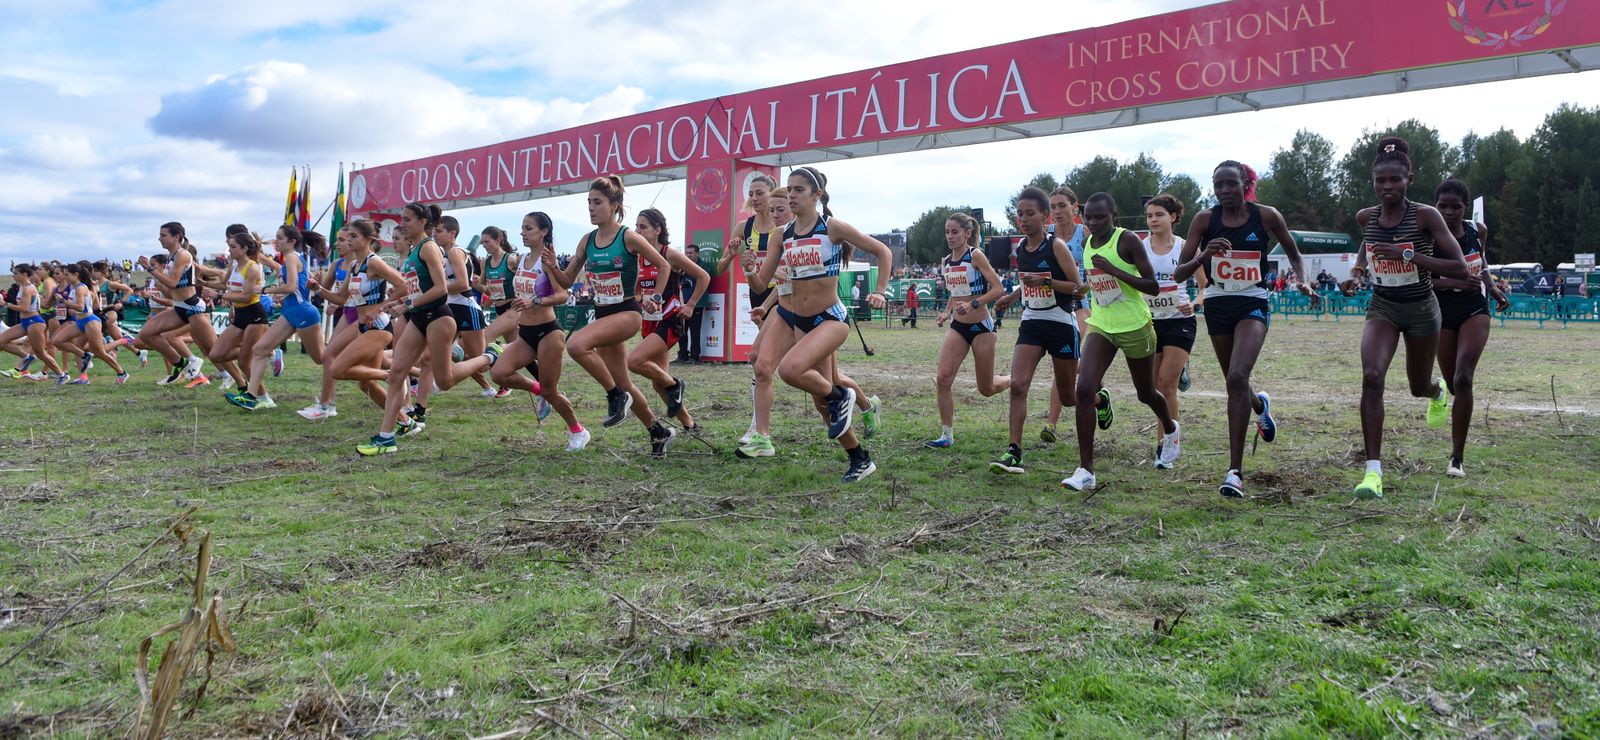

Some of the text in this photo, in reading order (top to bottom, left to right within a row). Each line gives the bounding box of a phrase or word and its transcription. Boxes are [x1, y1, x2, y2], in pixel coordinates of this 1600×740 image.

[1068, 0, 1336, 69] INTERNATIONAL
[1065, 40, 1355, 107] CROSS COUNTRY
[401, 58, 1039, 203] CROSS INTERNACIONAL ITÁLICA
[786, 248, 820, 267] Machado
[1217, 261, 1260, 281] Can
[1148, 297, 1174, 308] 1601
